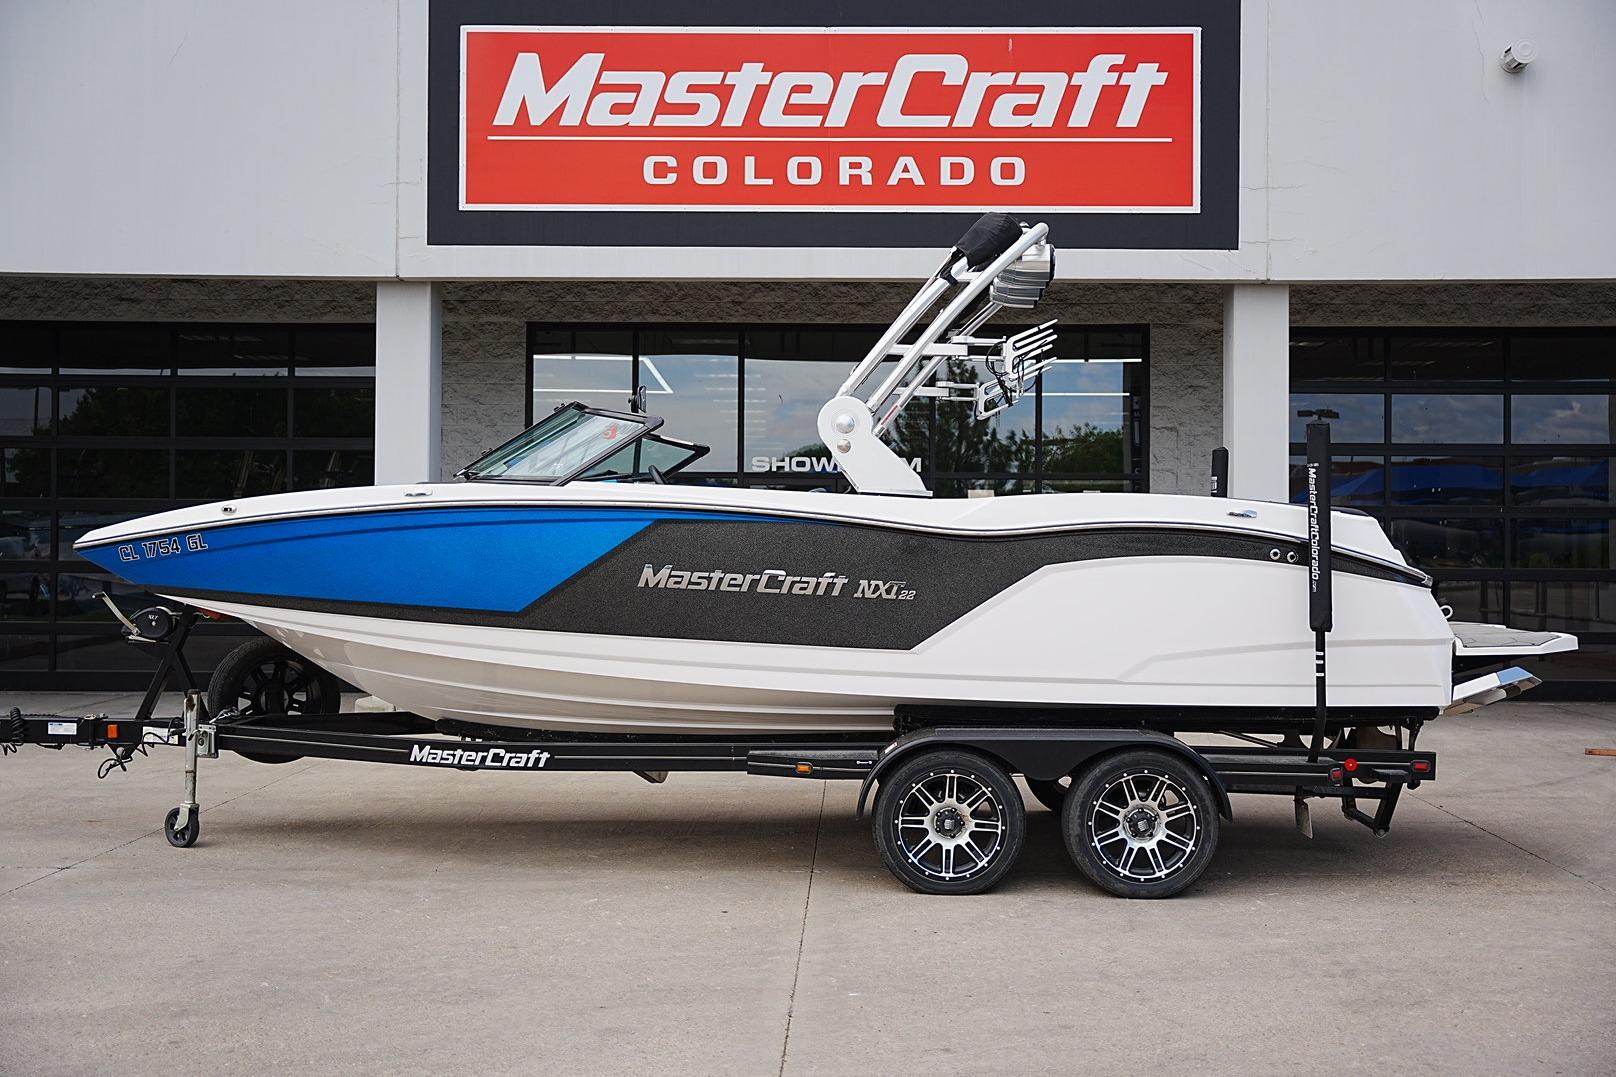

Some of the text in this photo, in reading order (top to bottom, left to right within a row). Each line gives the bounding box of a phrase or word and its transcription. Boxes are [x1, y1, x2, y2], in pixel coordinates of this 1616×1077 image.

[492, 52, 1168, 129] MasterCraft
[642, 154, 1027, 187] COLORADO
[751, 456, 922, 473] SHOWM
[119, 533, 208, 561] CL 1754 GL
[637, 563, 848, 596] MasterCraft
[410, 744, 551, 768] MasterCraft
